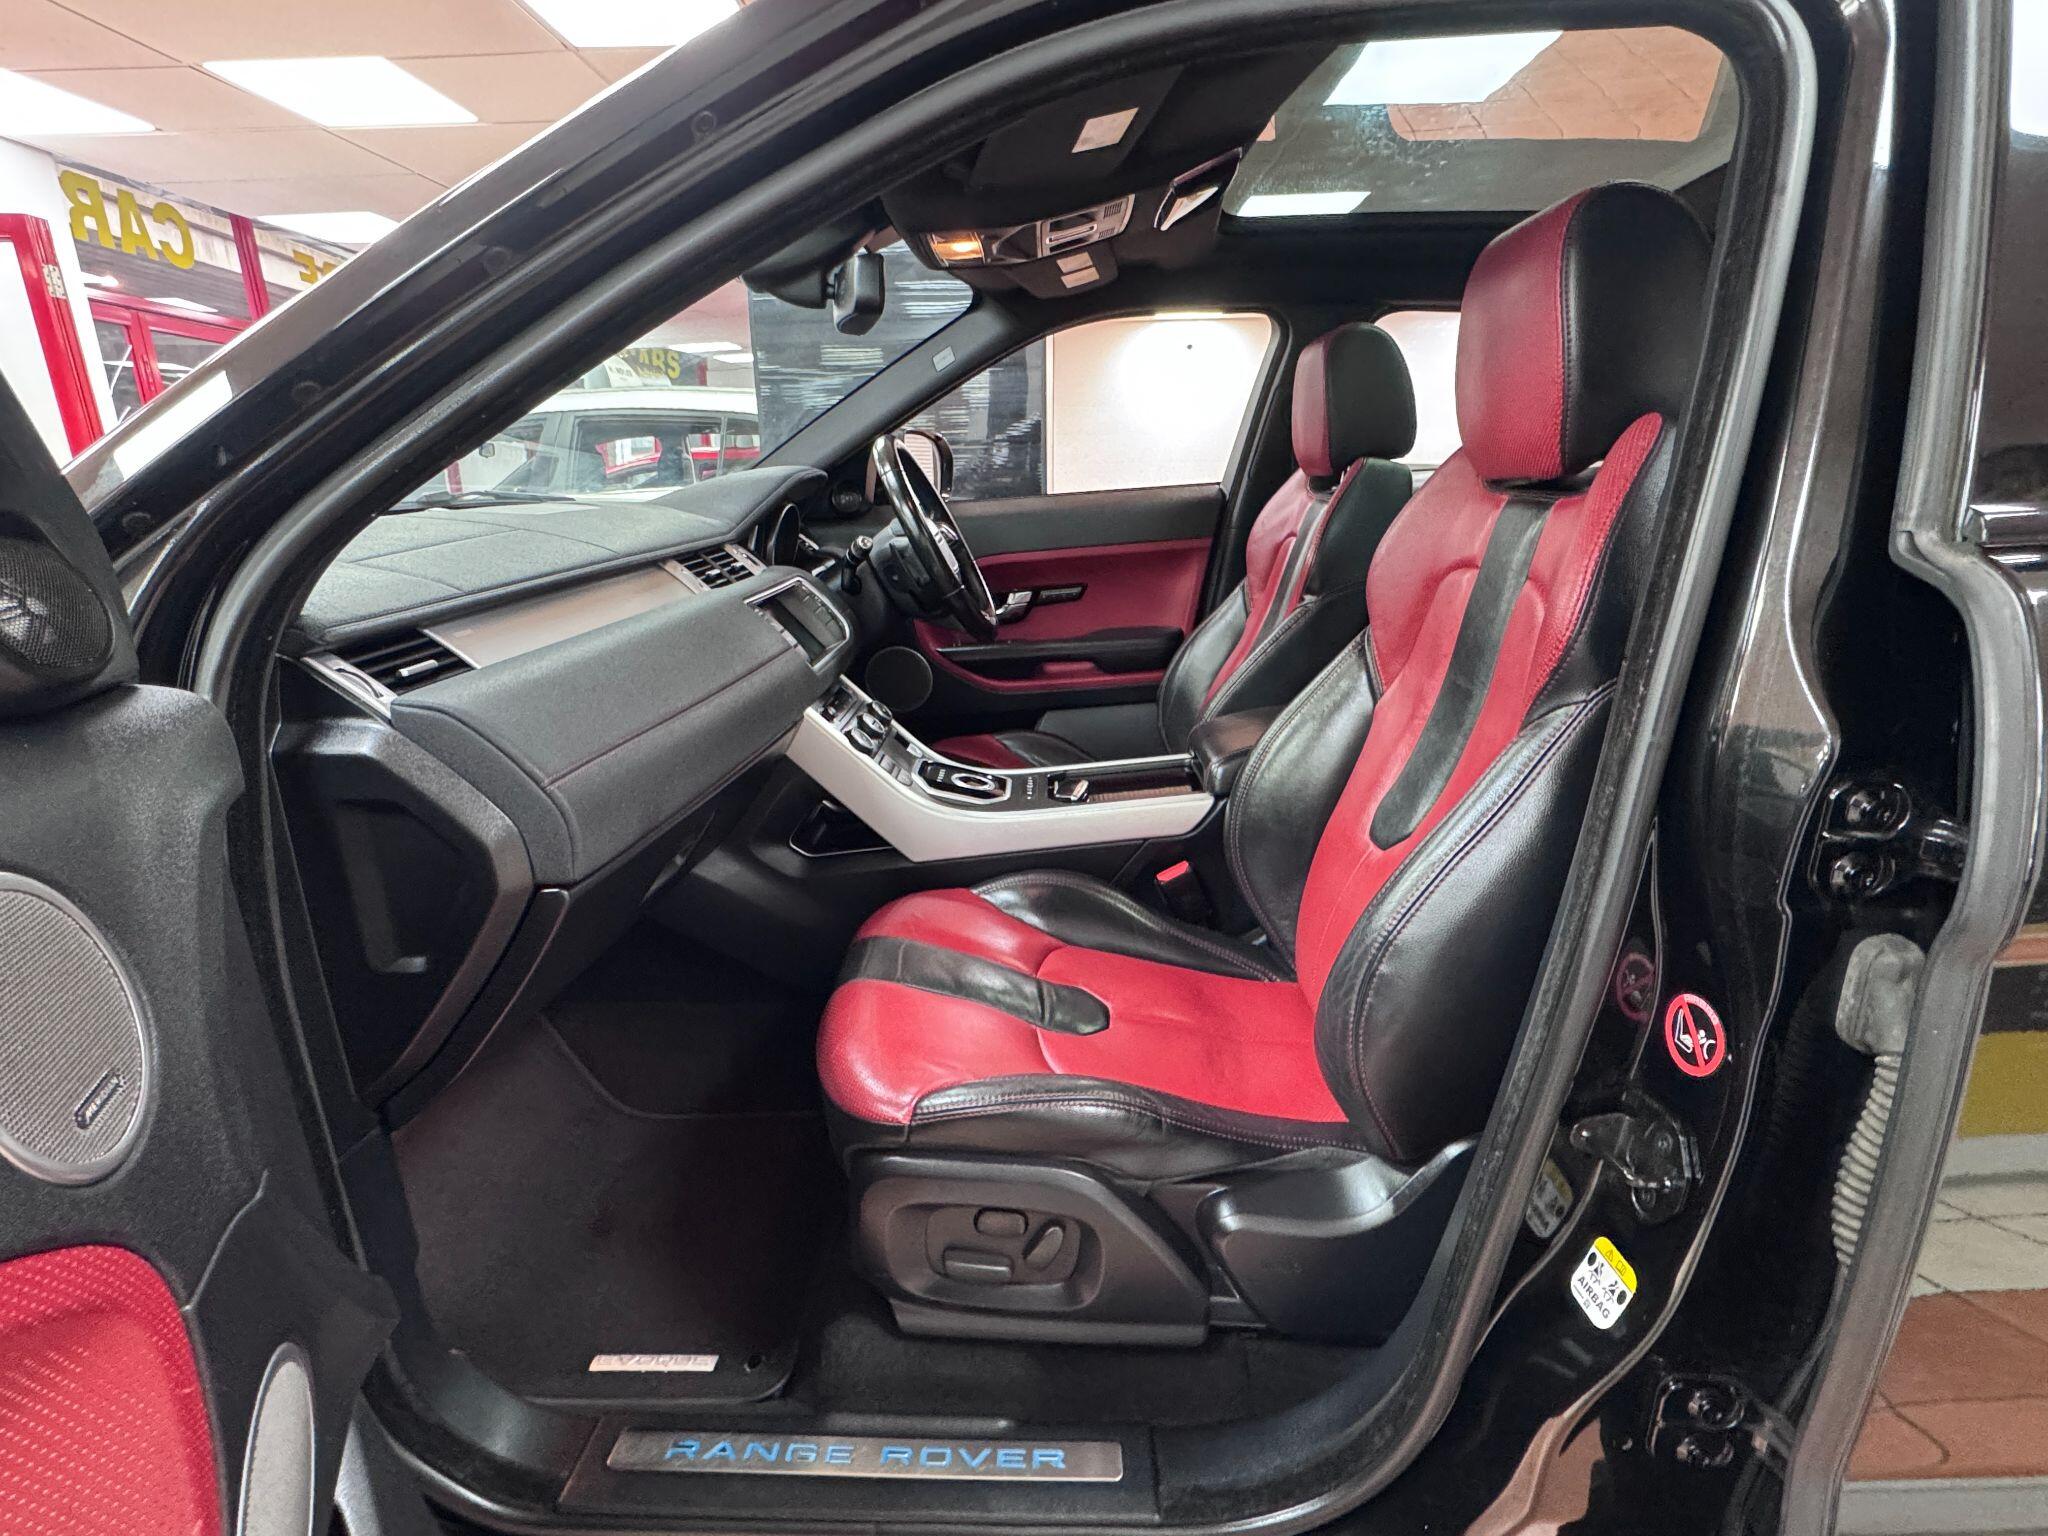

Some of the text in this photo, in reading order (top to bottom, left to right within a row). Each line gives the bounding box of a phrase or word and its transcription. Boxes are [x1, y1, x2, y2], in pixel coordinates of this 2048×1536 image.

[1577, 1276, 1611, 1319] AIRBAG
[664, 1438, 1067, 1470] RANGE ROVER
